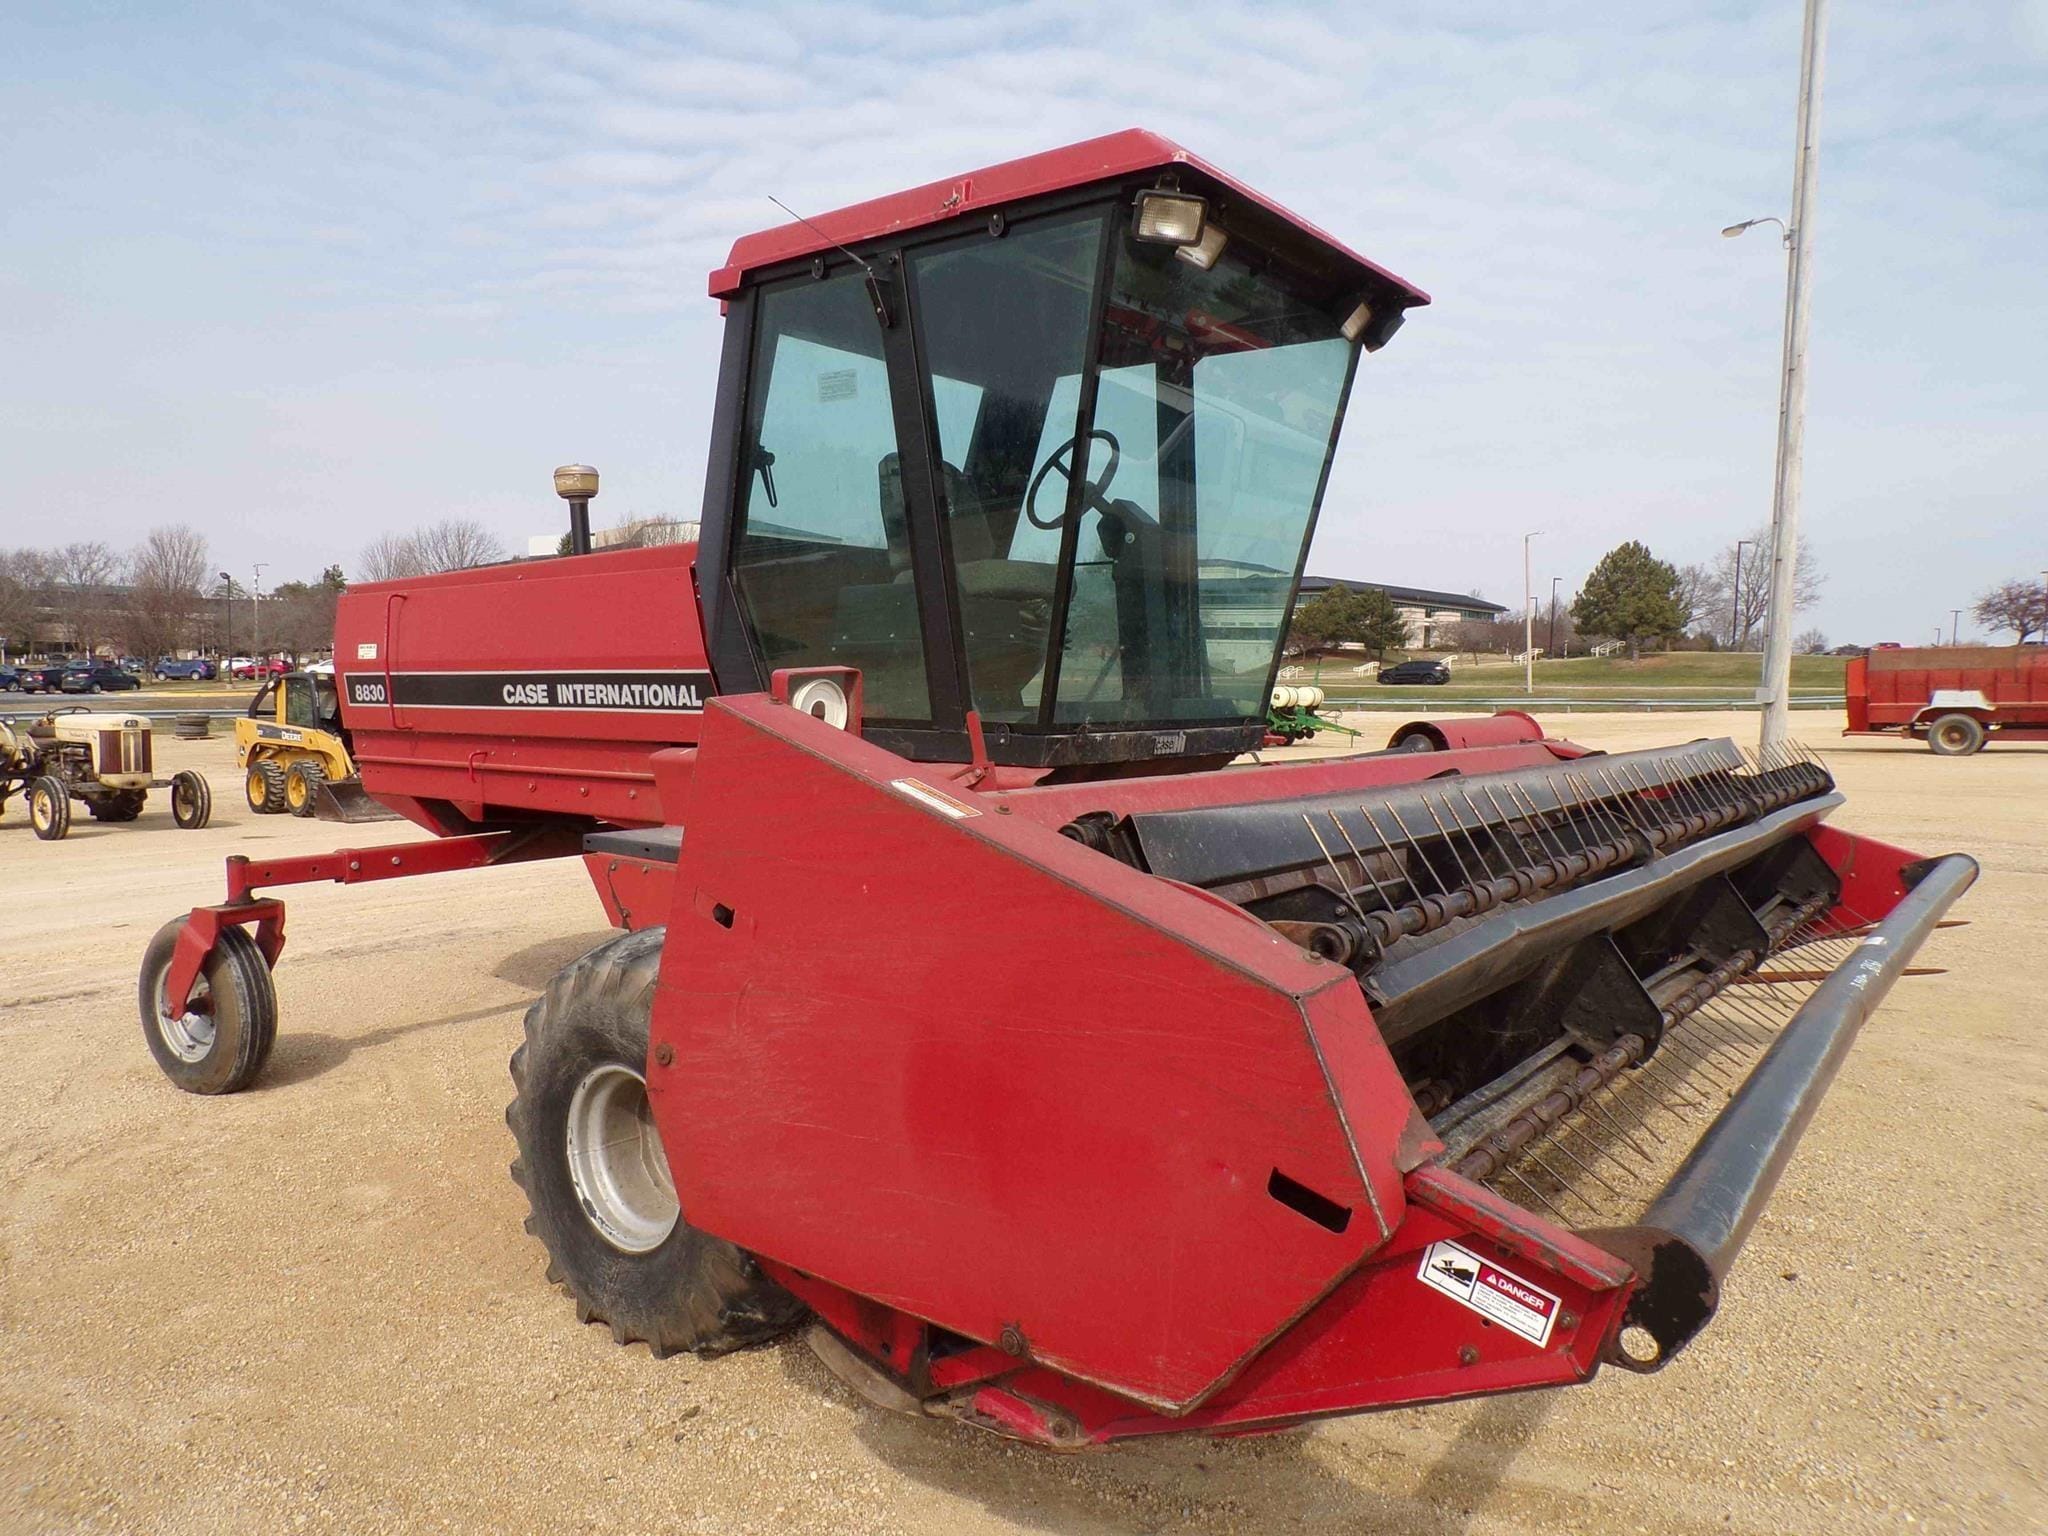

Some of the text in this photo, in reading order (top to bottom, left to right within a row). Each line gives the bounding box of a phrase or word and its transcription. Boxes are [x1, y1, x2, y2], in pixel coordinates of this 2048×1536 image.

[355, 684, 385, 702] 8830
[503, 683, 703, 707] CASE INTERNATIONAL
[1497, 1278, 1545, 1310] DANGER
